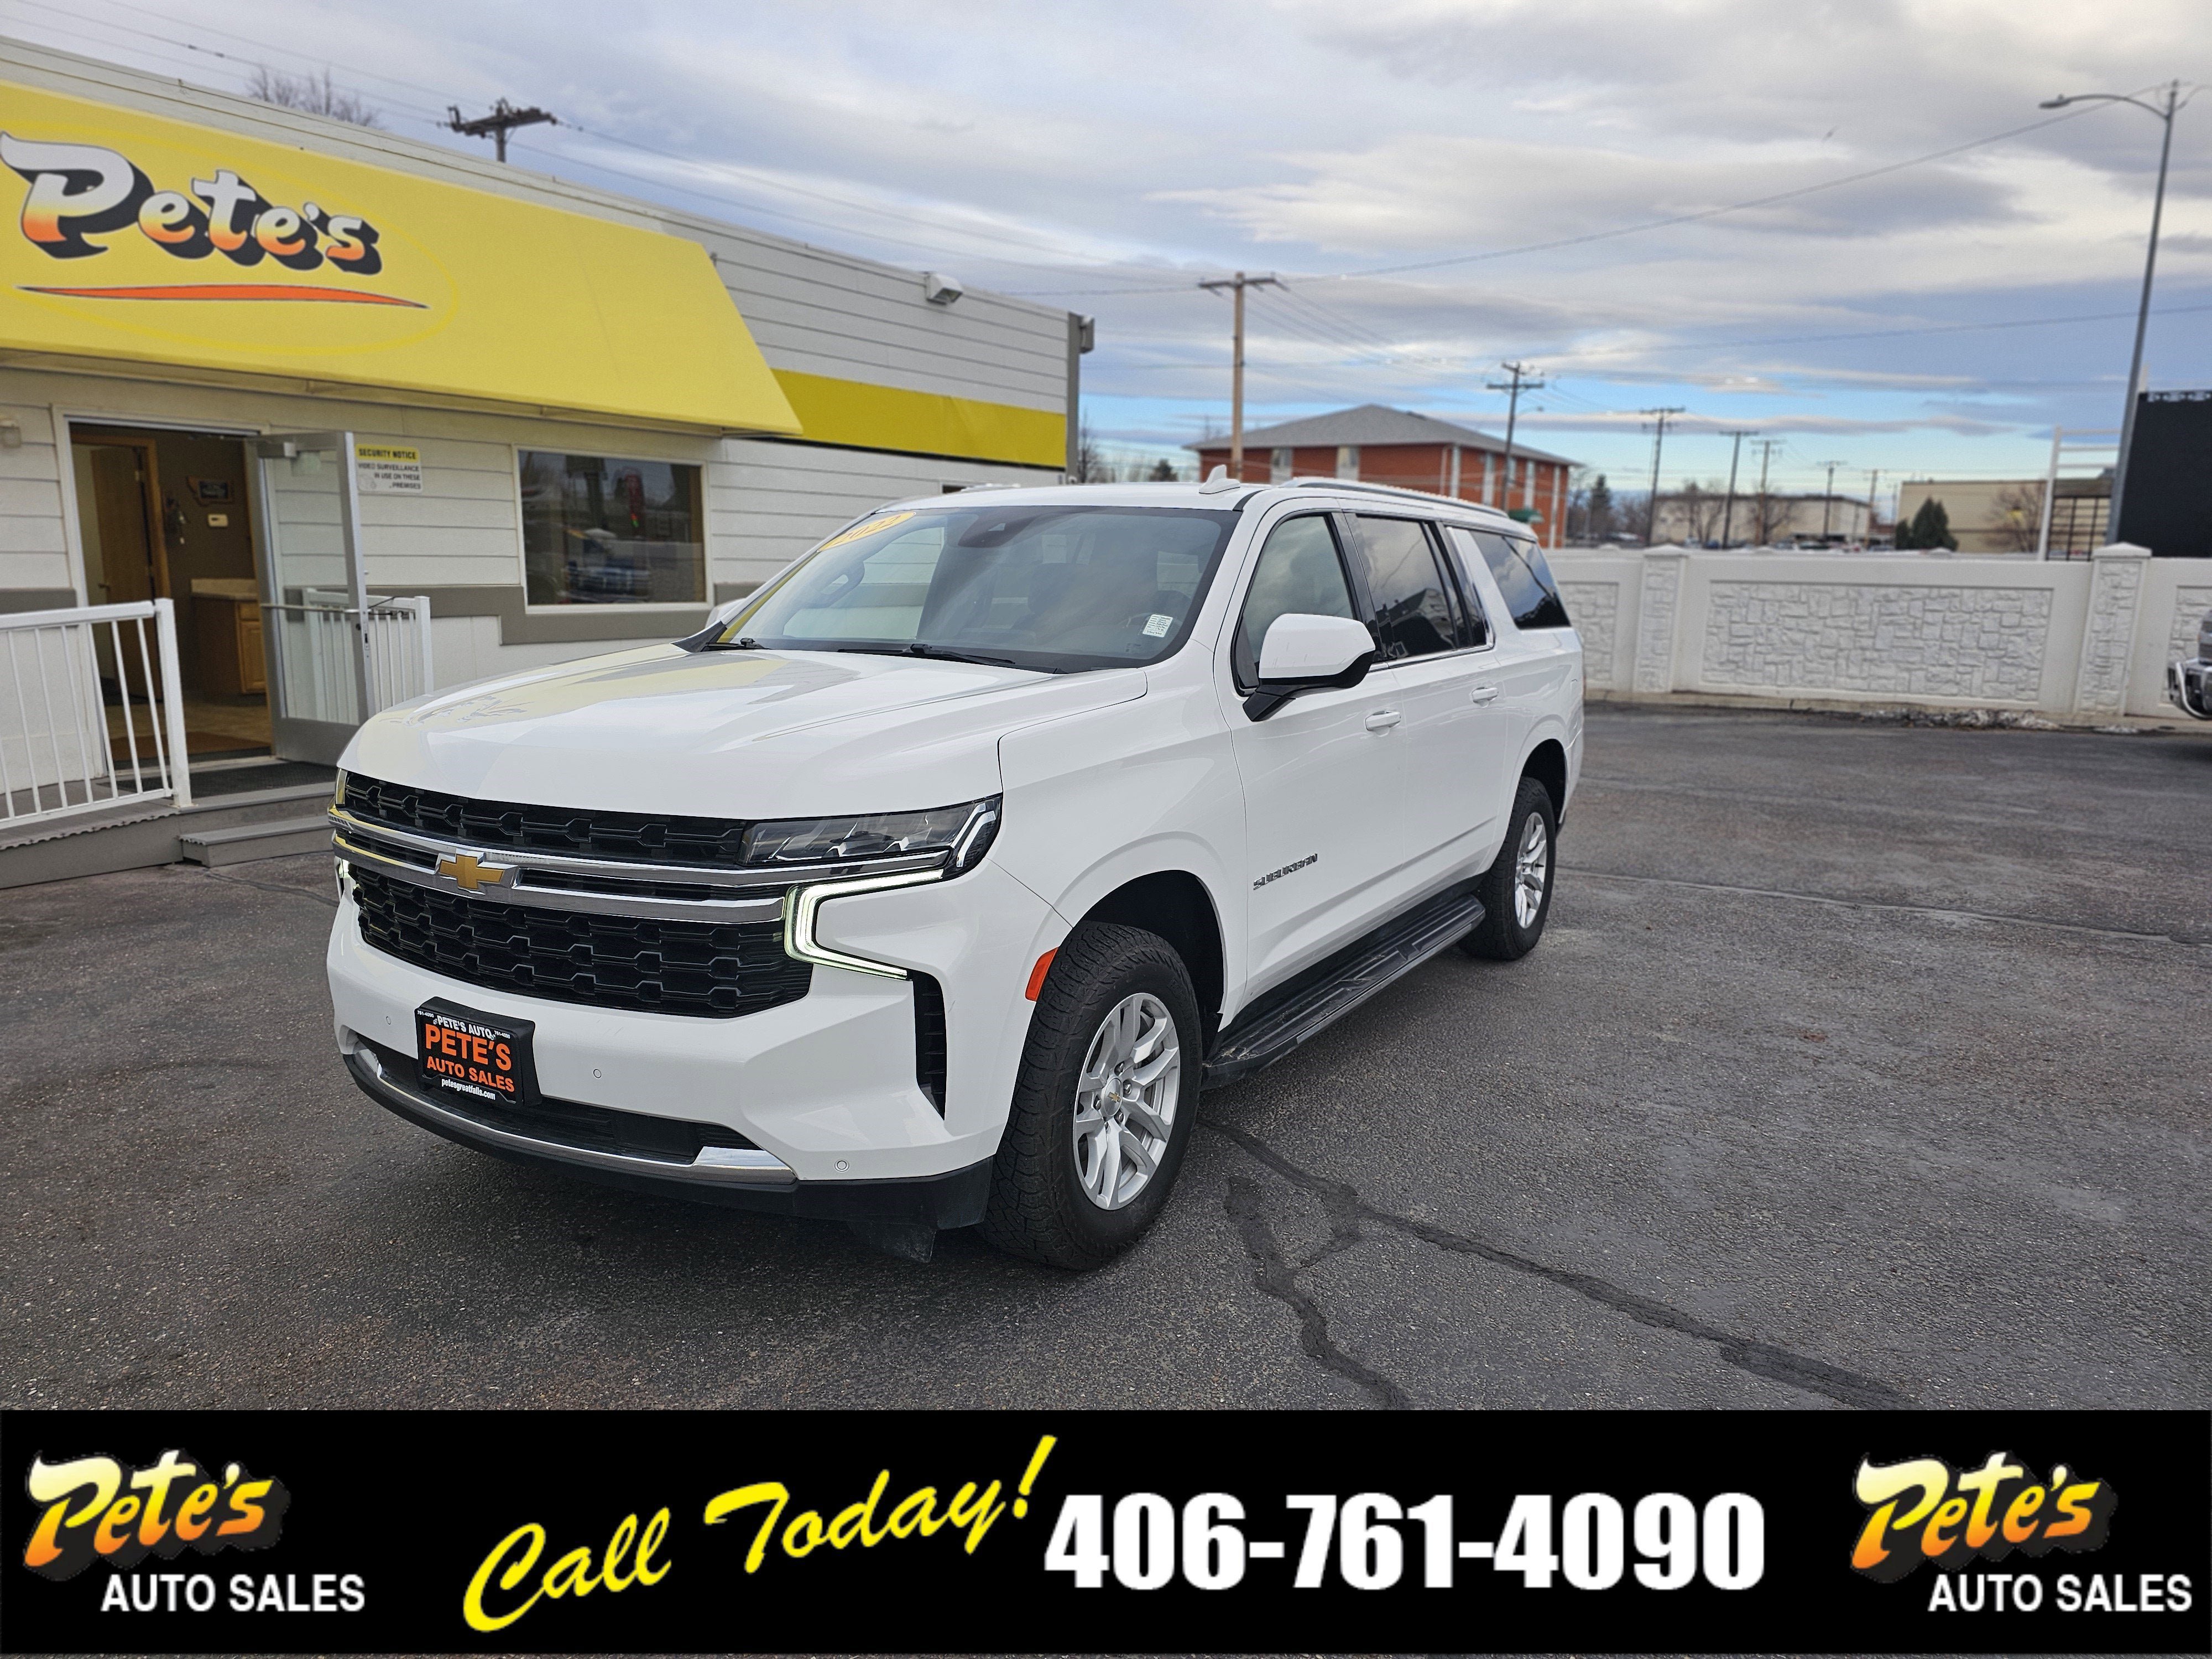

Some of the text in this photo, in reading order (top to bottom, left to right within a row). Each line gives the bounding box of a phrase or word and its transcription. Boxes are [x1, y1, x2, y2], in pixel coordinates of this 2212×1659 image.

[0, 132, 382, 275] Pete's
[359, 448, 416, 459] SECURITY NOTICE
[1253, 853, 1317, 890] SUBURBAN
[437, 1015, 492, 1040] PETE'S AUTO
[425, 1024, 512, 1071] PETE'S
[427, 1056, 515, 1092] AUTO SALES
[441, 1078, 495, 1100] petesgreatfalls.com
